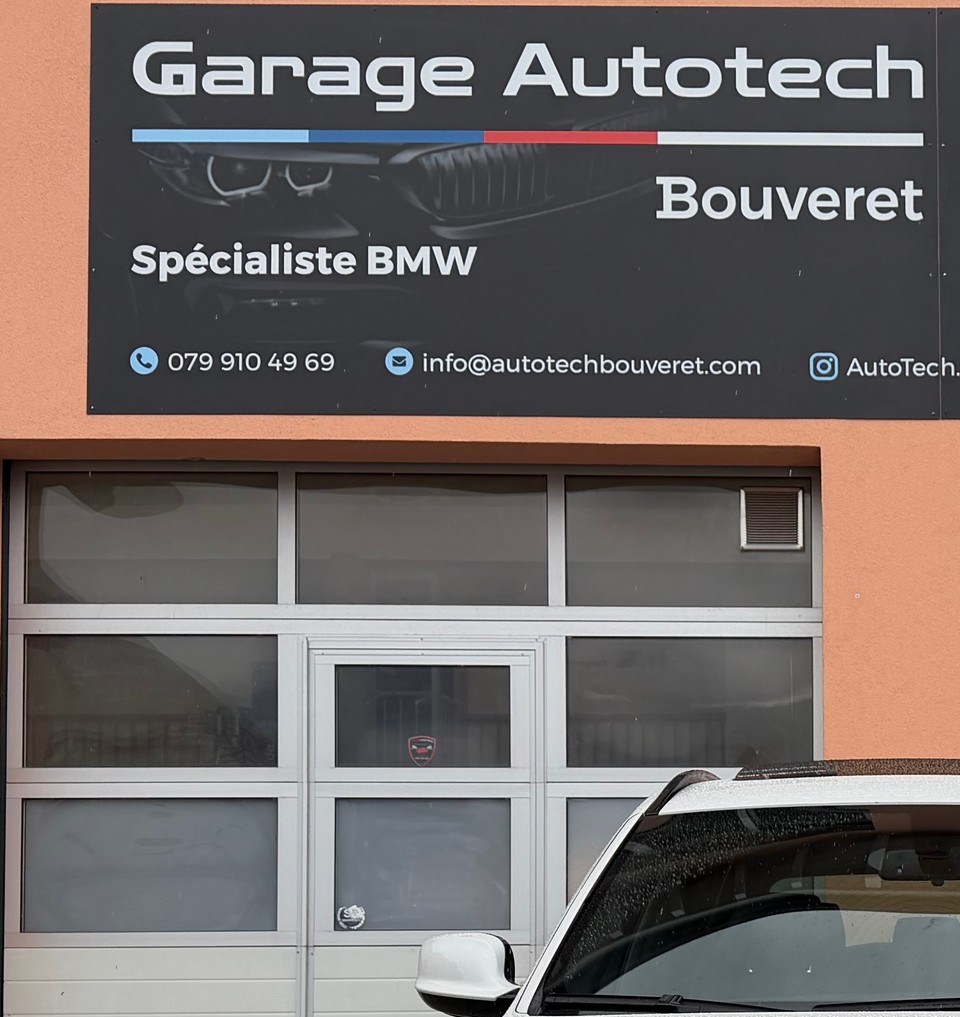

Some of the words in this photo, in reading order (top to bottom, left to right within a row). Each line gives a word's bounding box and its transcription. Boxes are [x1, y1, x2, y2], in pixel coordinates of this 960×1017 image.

[132, 41, 475, 112] Garage
[502, 42, 924, 99] Autotech
[655, 175, 924, 222] Bouveret
[130, 241, 357, 282] Spécialiste
[367, 245, 478, 276] BMW
[168, 352, 214, 372] 079
[220, 352, 262, 372] 910
[267, 352, 298, 372] 49
[304, 352, 335, 372] 69
[422, 352, 761, 377] info@autotechbouveret.com
